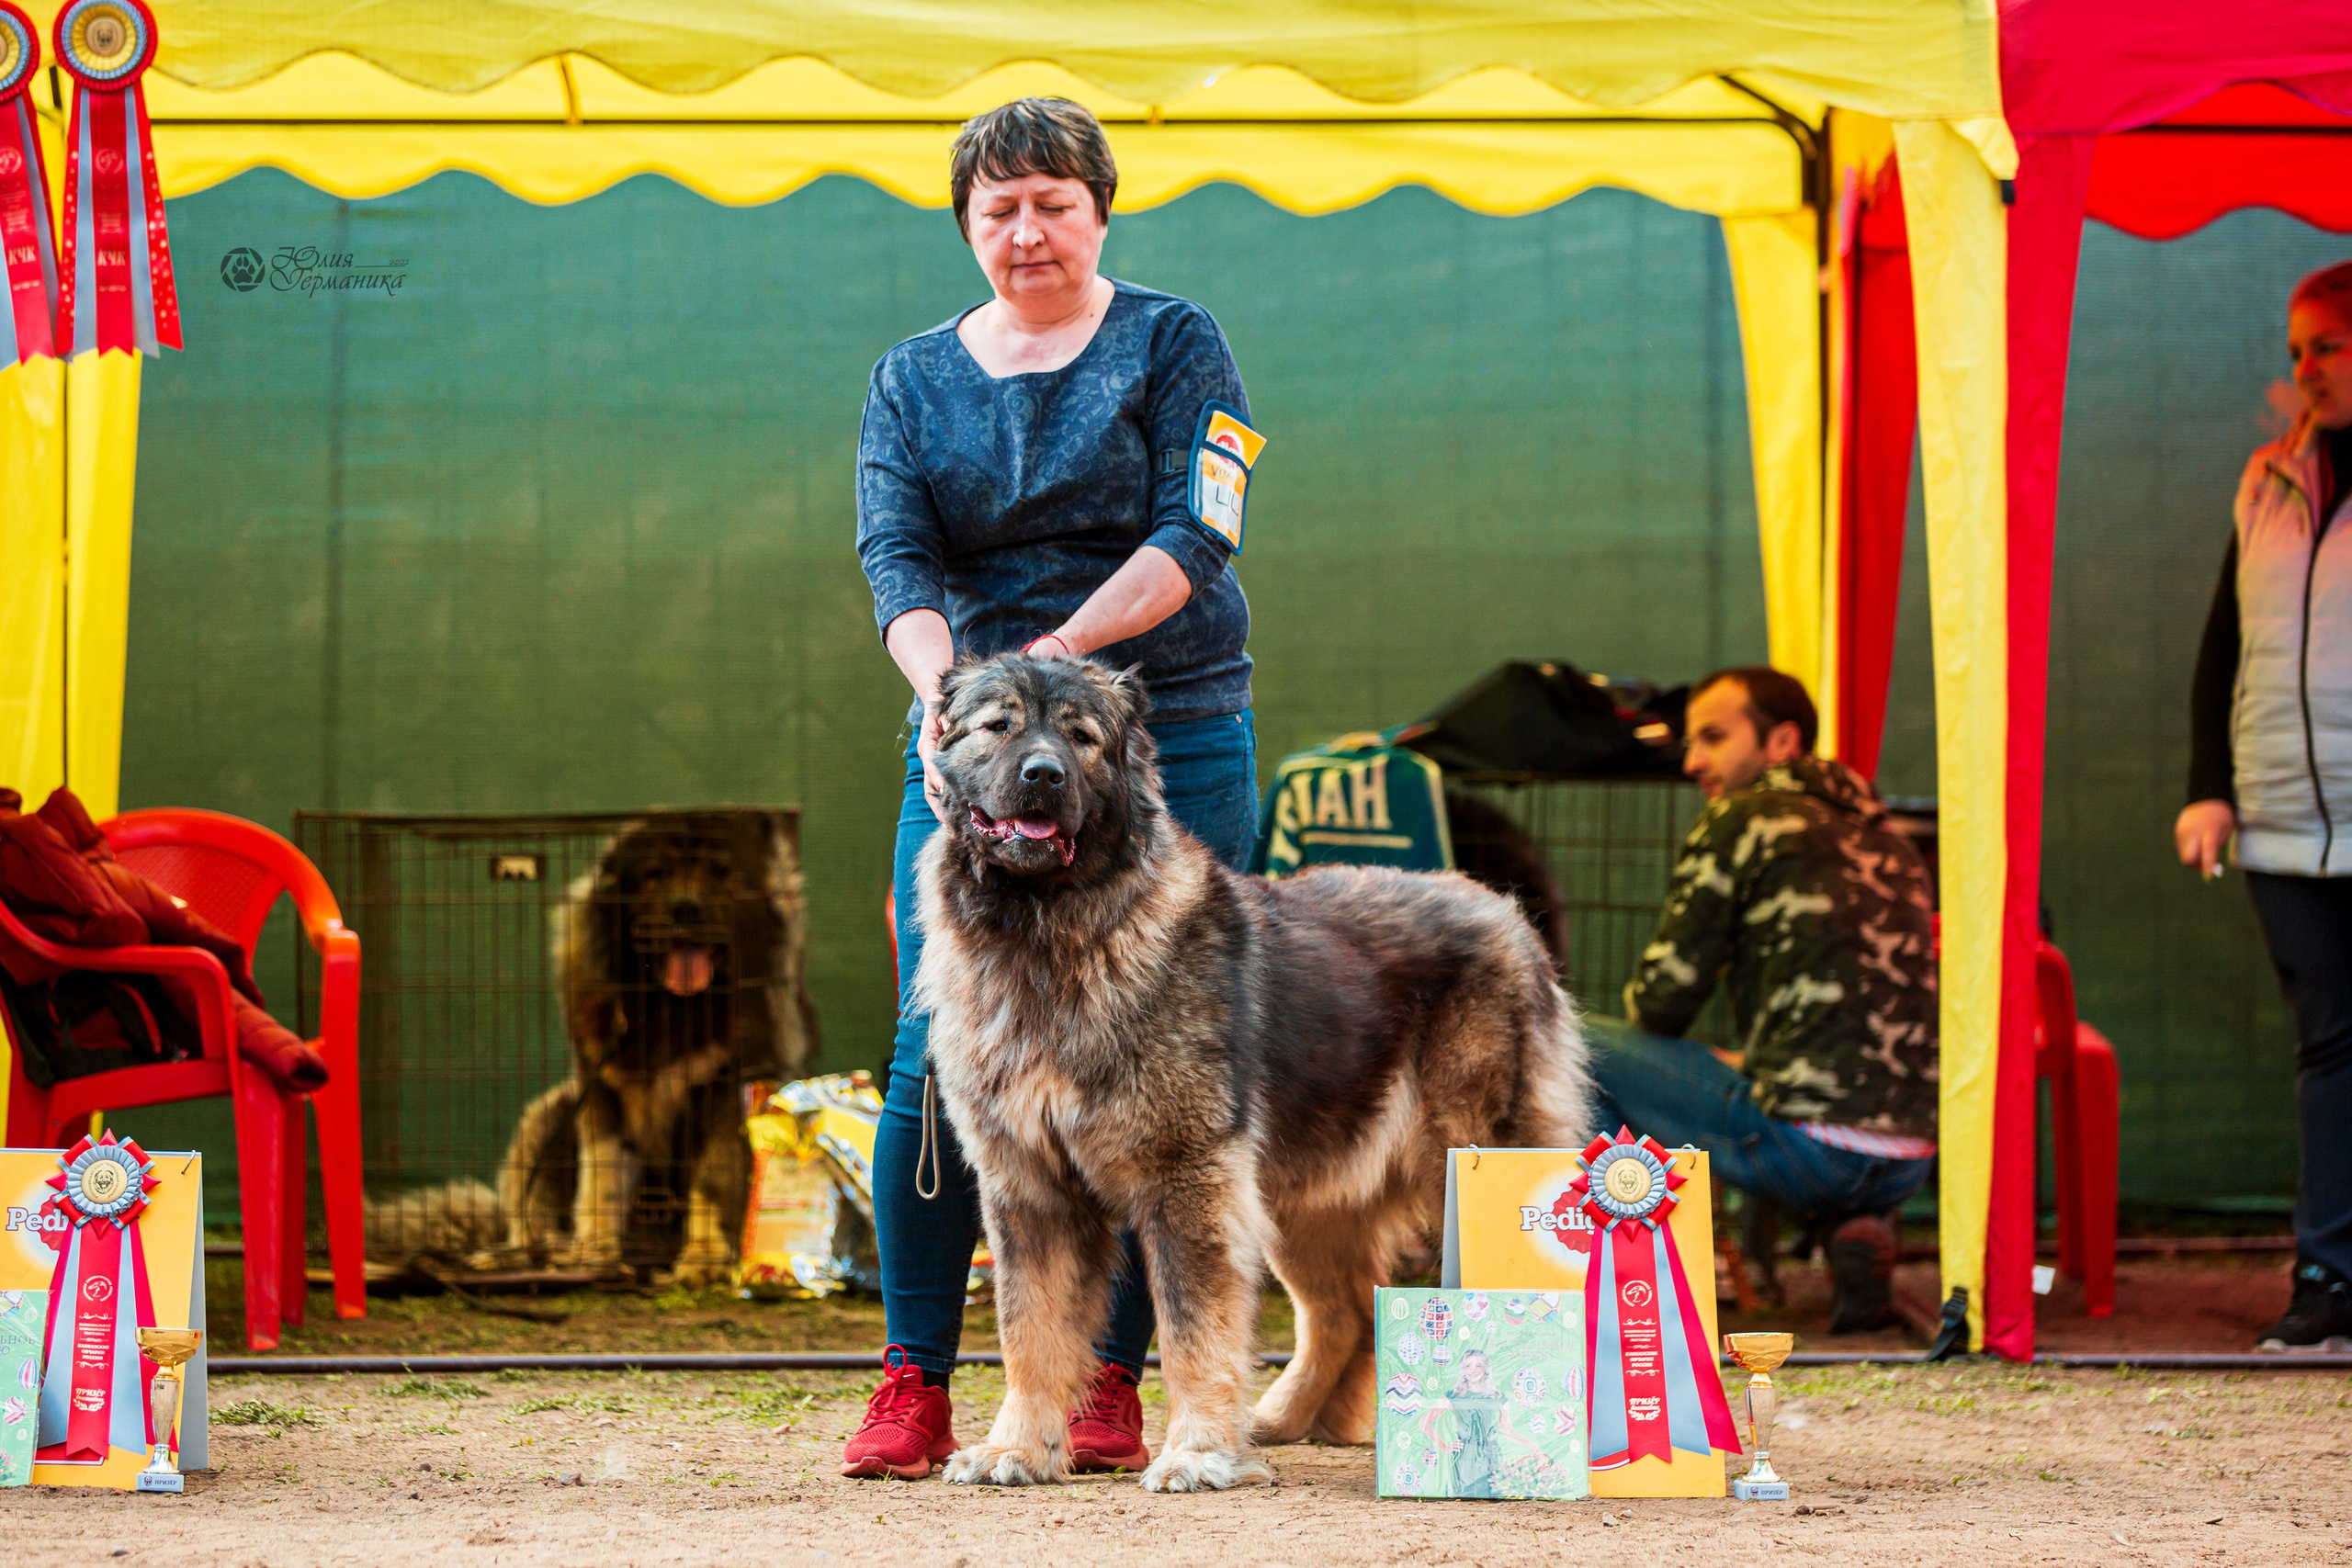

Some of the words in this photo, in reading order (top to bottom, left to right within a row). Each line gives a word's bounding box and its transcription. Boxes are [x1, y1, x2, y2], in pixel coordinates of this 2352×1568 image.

[97, 248, 126, 266] КЧК
[75, 1388, 106, 1397] ПРИЗЁР
[1628, 1395, 1661, 1405] ПРИЗЁР
